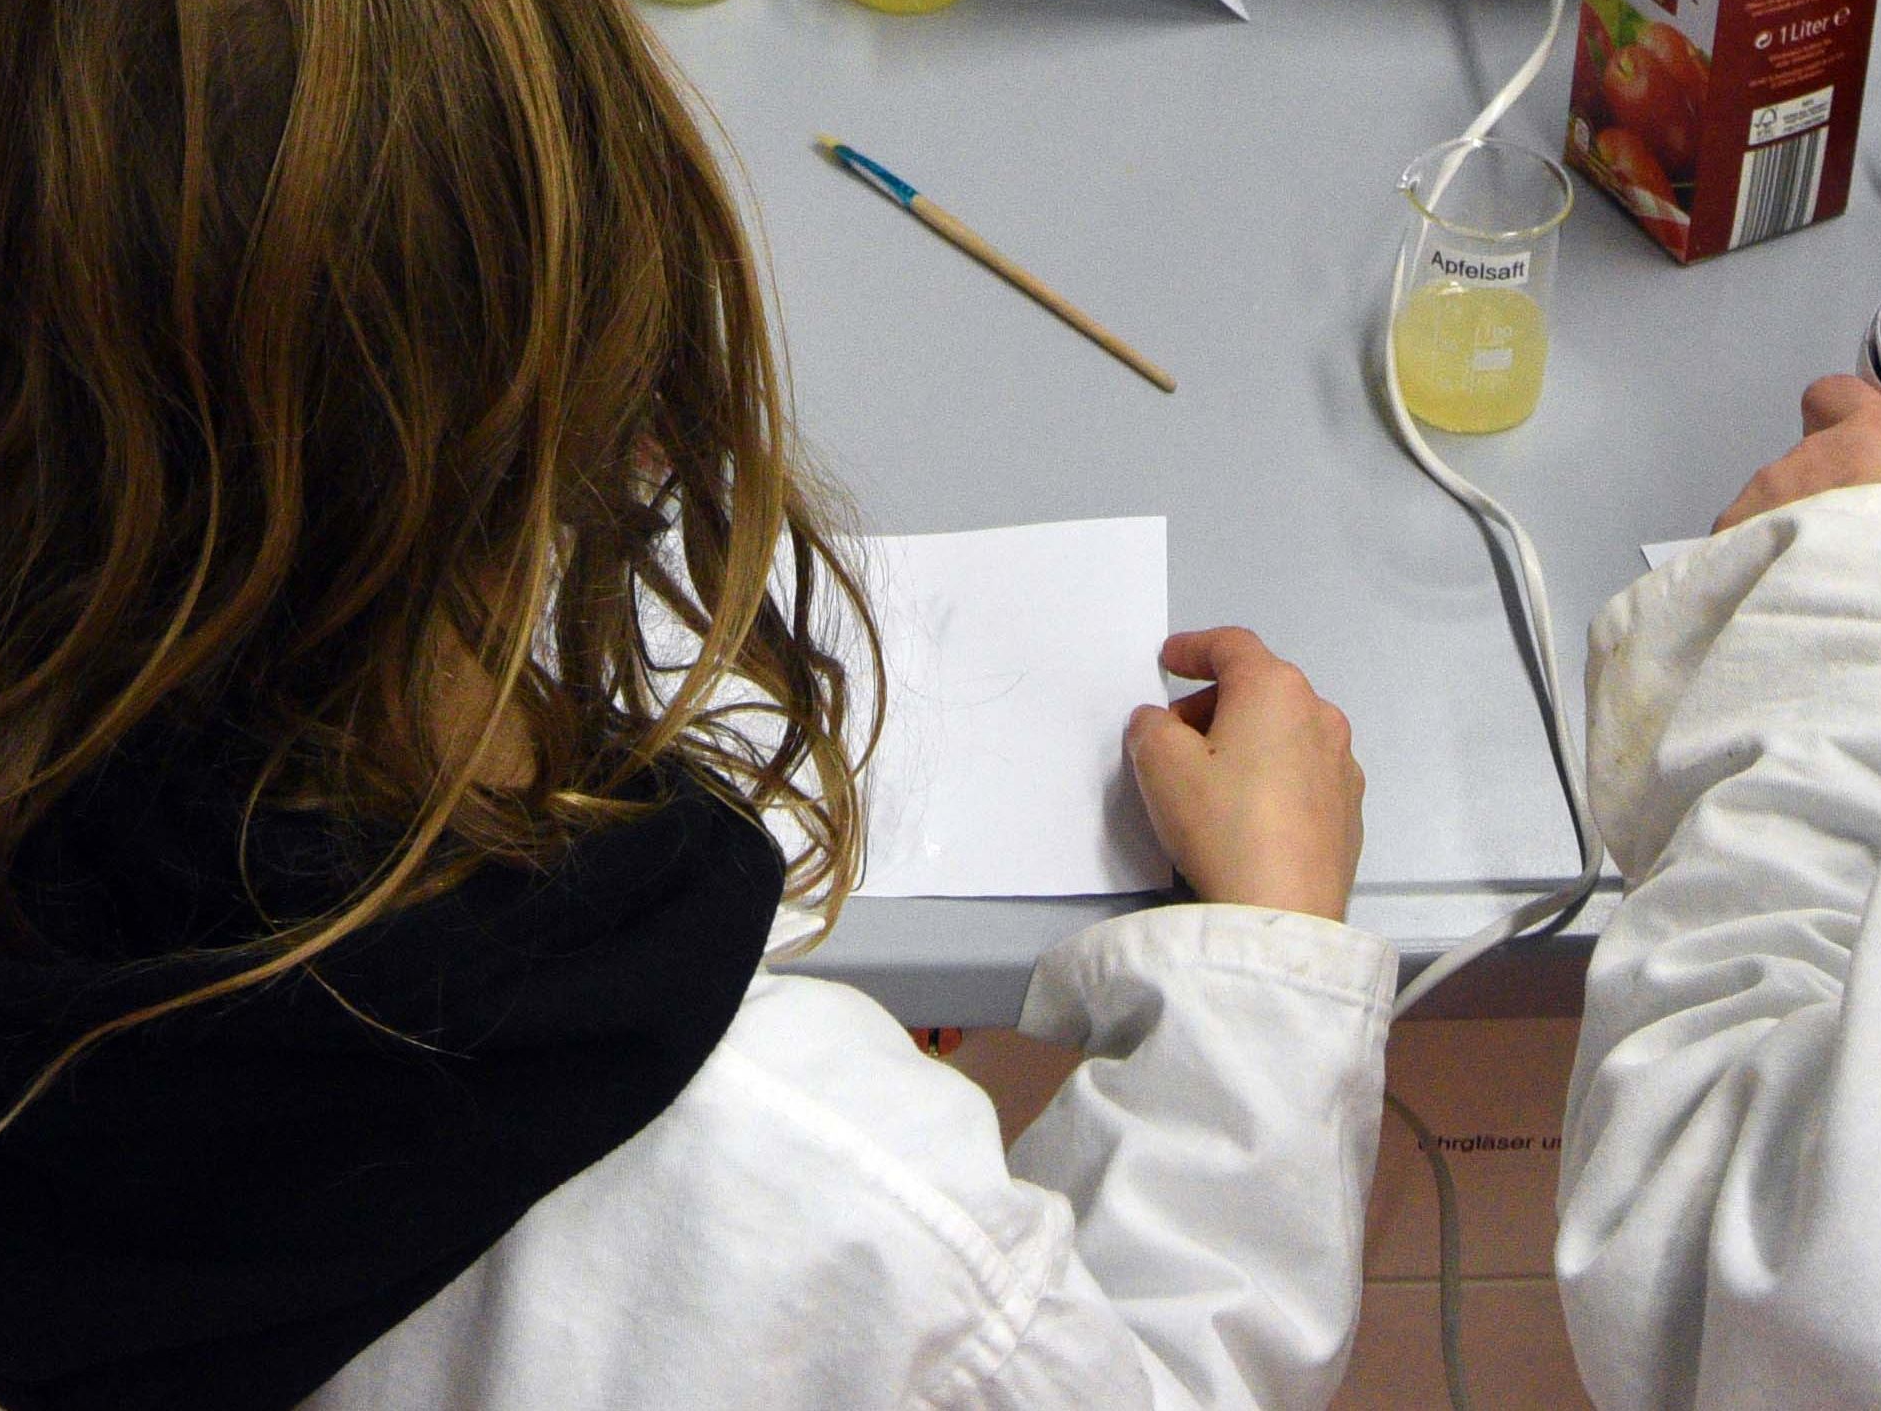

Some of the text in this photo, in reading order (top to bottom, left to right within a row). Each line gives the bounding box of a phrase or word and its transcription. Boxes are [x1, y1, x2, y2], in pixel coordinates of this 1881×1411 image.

[1780, 16, 1831, 46] 1 Liter
[1431, 250, 1526, 281] Apfelsaft
